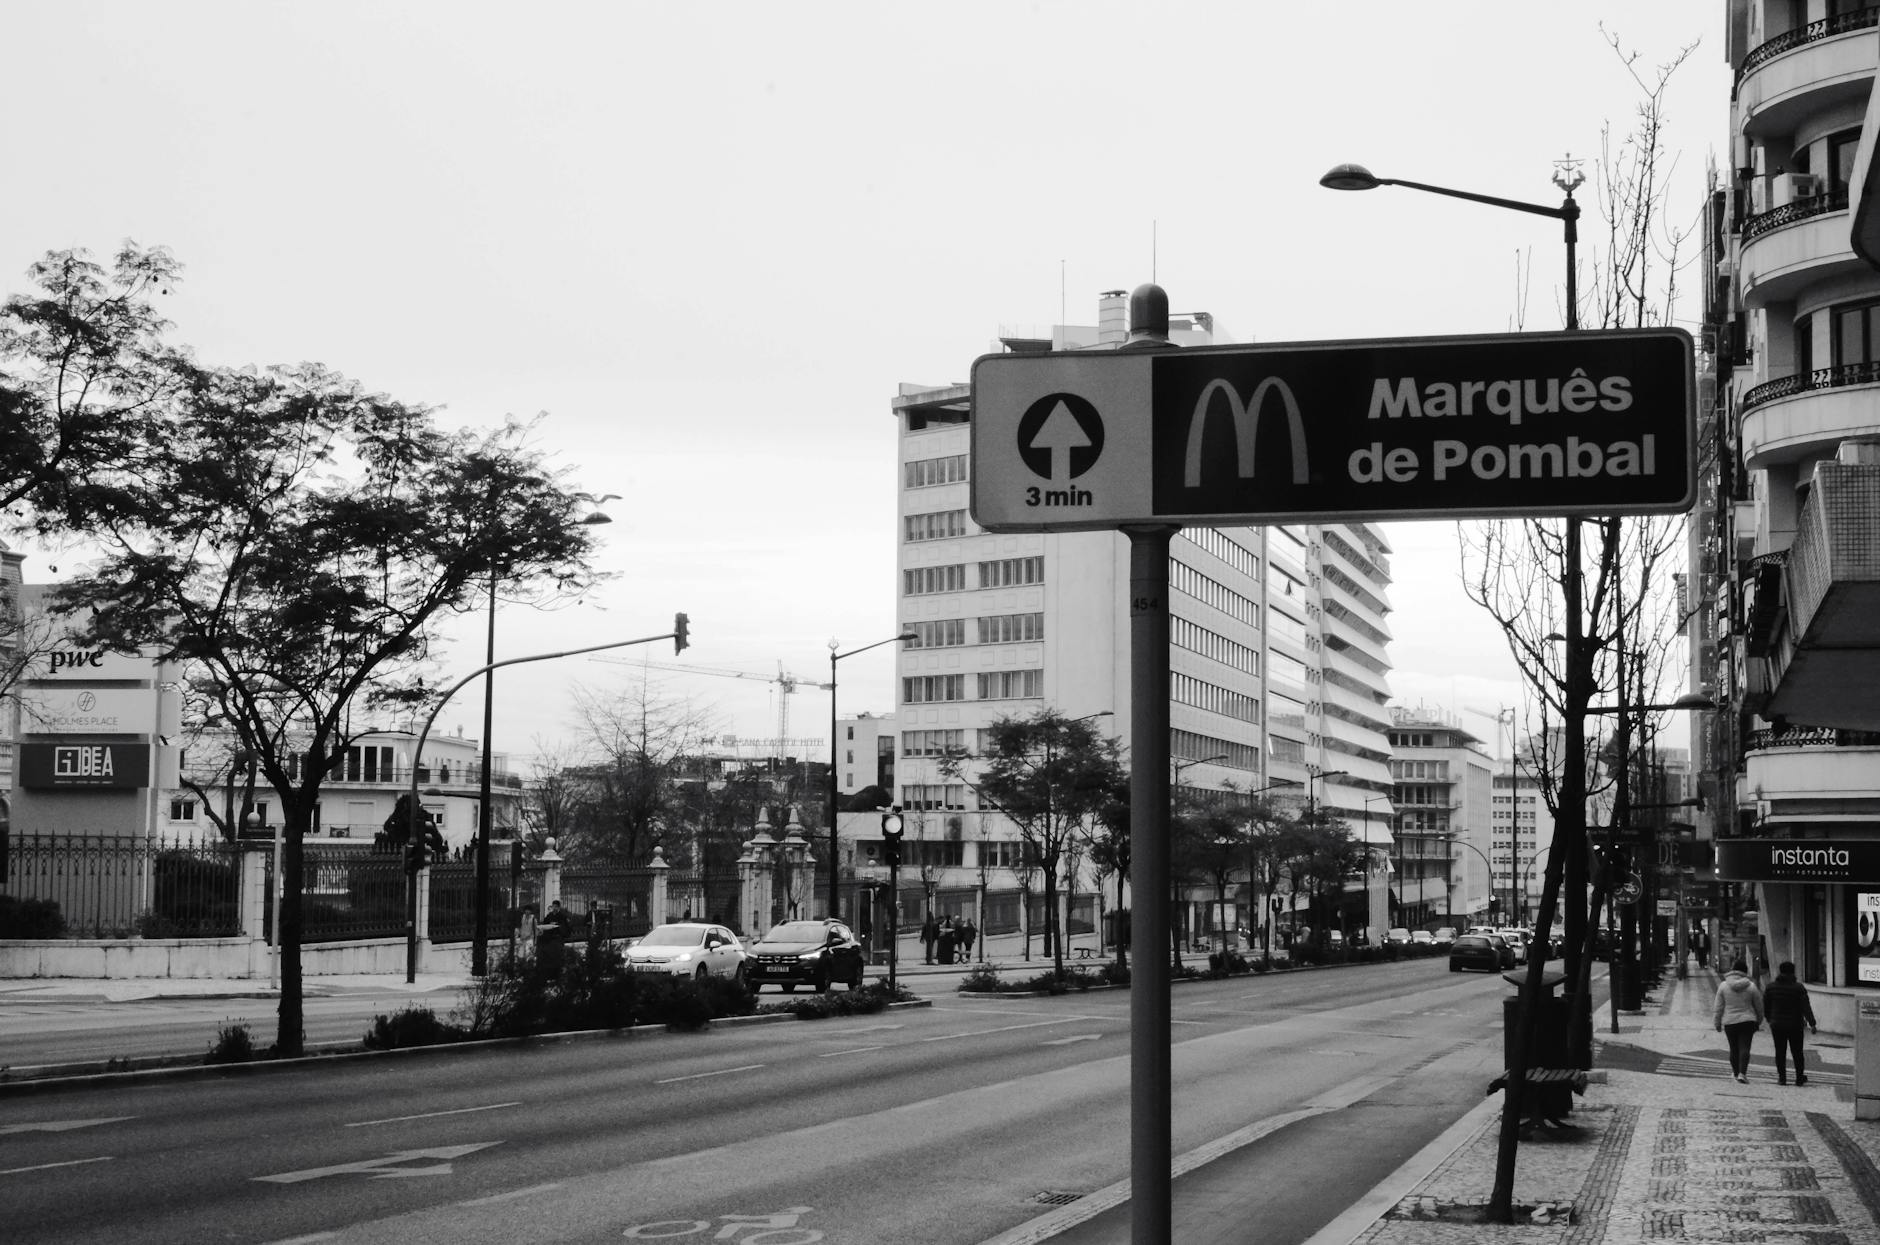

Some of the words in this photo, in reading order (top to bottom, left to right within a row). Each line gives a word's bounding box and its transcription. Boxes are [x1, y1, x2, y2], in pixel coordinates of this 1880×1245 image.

[1367, 367, 1633, 425] Marquês
[1348, 442, 1420, 484] de
[1433, 434, 1656, 481] Pombal
[1025, 486, 1041, 507] 3
[1045, 484, 1093, 507] min
[49, 651, 103, 674] pwc
[91, 716, 119, 726] PLACE
[1771, 845, 1850, 866] instanta
